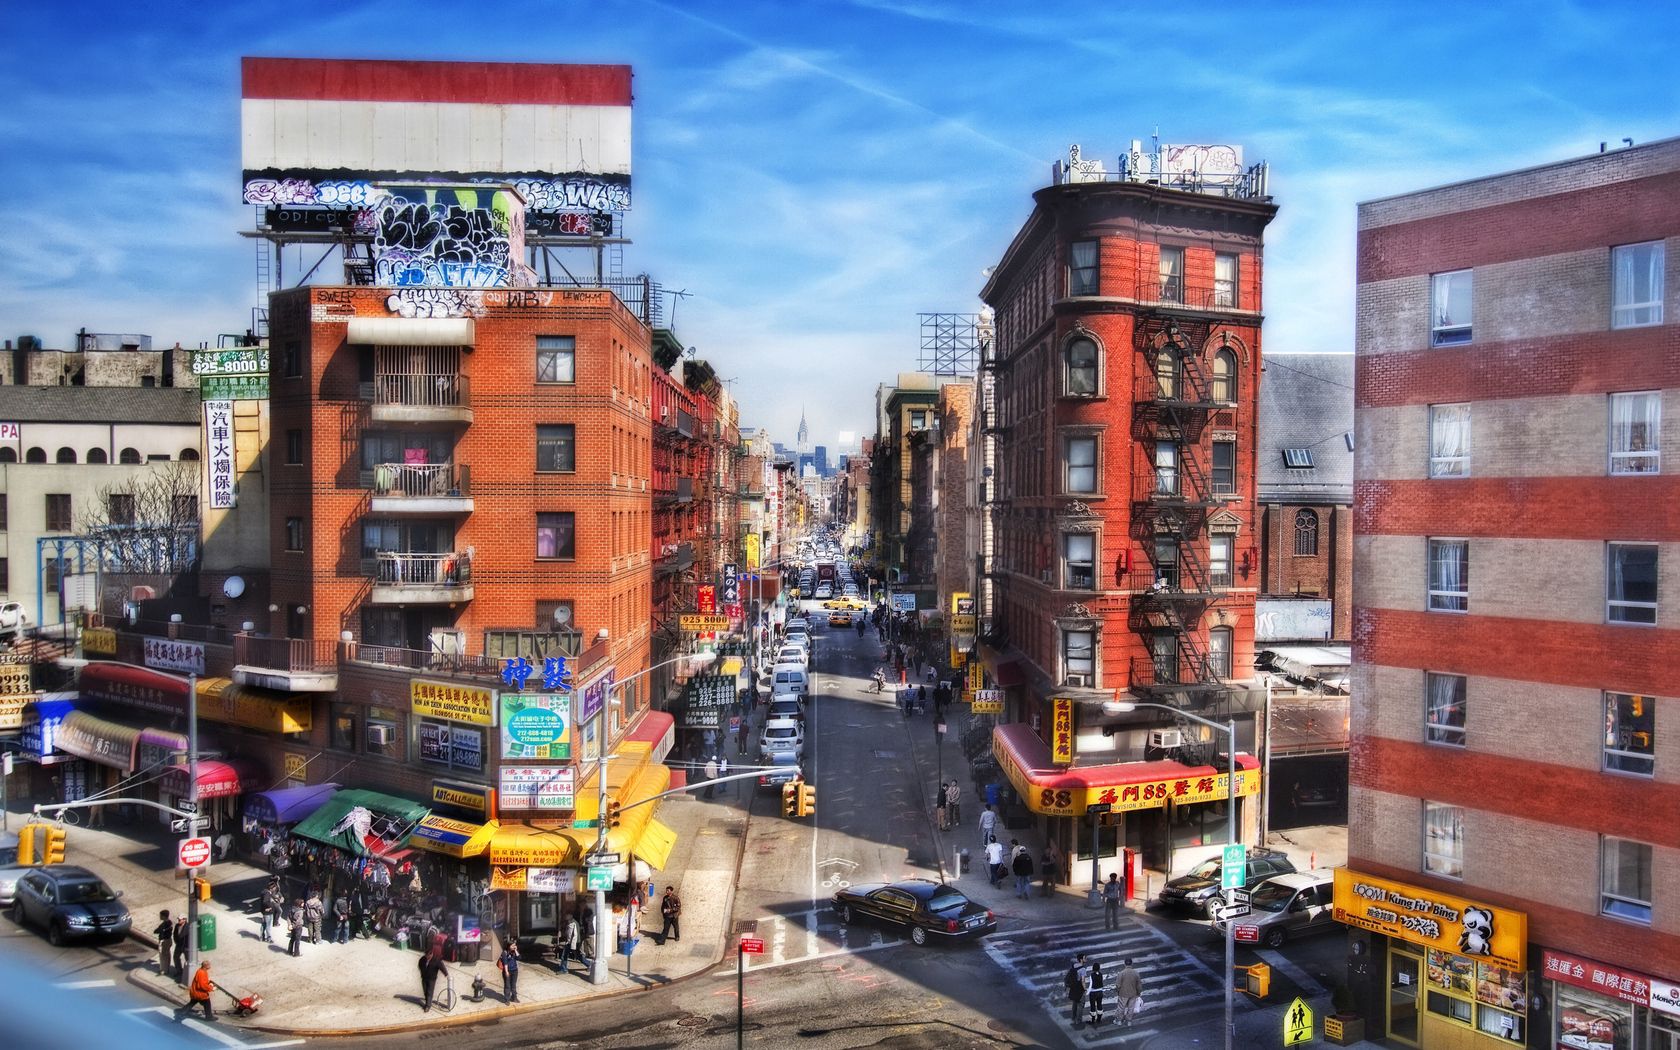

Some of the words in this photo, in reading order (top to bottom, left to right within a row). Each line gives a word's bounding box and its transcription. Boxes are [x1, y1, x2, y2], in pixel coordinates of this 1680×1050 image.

[193, 360, 257, 374] 925-8000
[212, 412, 231, 506] 汽車火燭保險
[683, 616, 701, 624] 925
[704, 616, 727, 624] 8000
[443, 702, 470, 713] ASSOCIATION
[471, 706, 478, 714] OF
[1041, 789, 1072, 808] 88
[1235, 892, 1247, 900] WAY
[1236, 906, 1248, 914] WAY
[1388, 892, 1414, 910] Kung
[1432, 903, 1457, 922] Bing
[1546, 957, 1585, 978] 速匯金
[1592, 969, 1648, 997] 國際匯款
